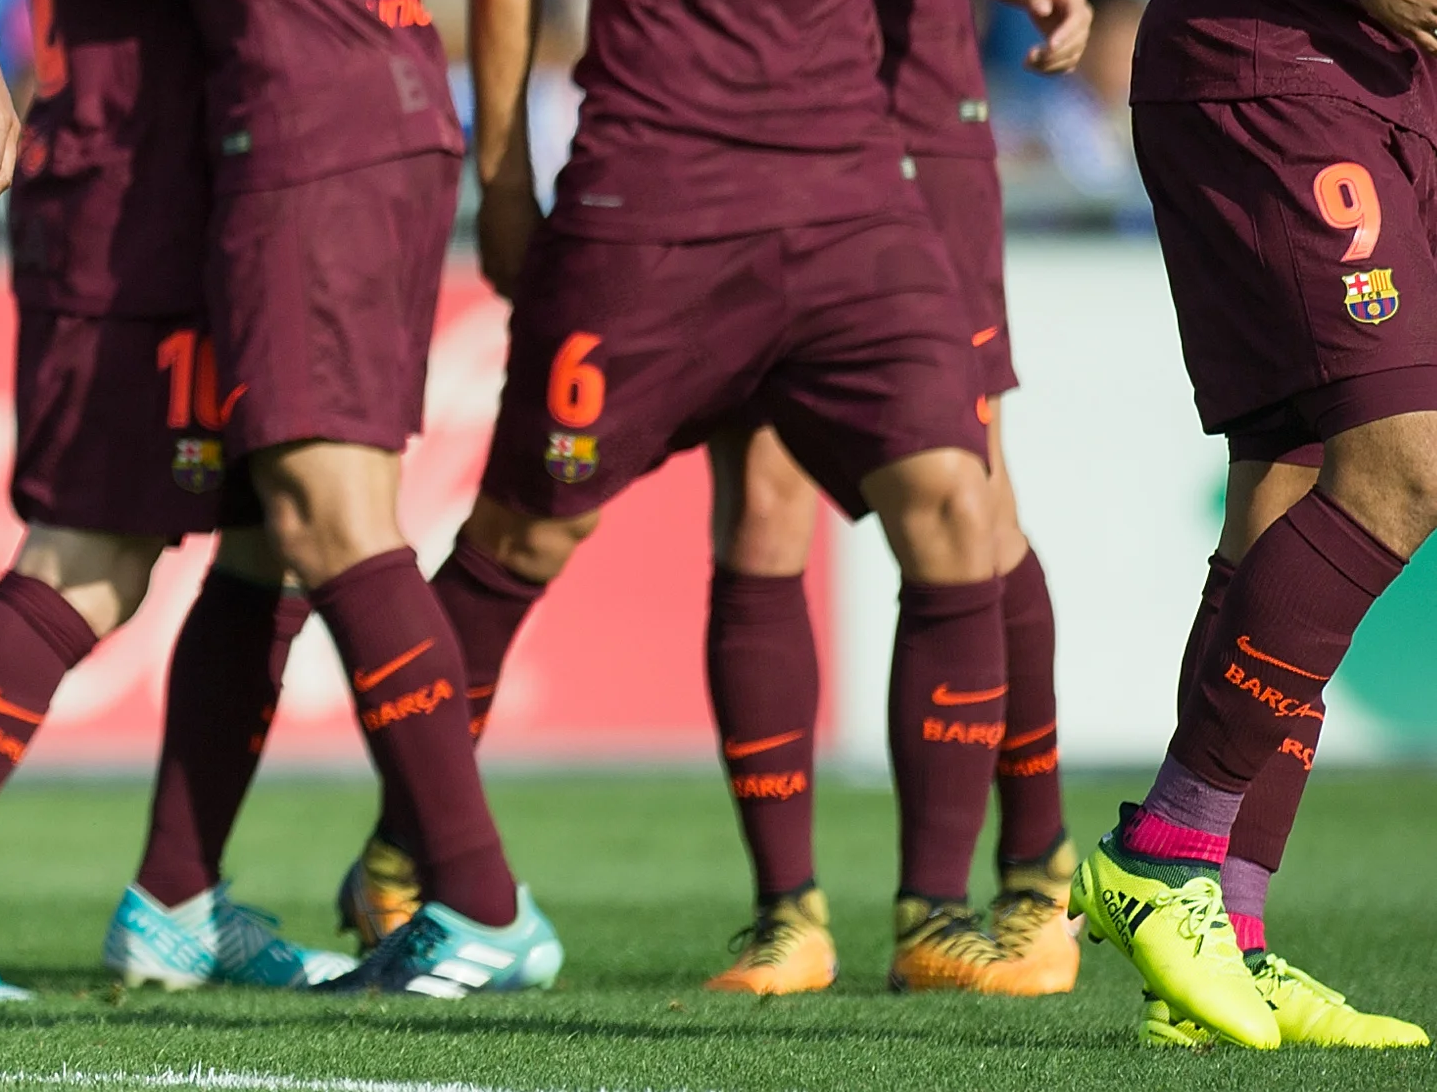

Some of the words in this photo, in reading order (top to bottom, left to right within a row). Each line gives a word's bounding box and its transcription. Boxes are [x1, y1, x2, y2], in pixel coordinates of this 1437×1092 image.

[1313, 162, 1382, 262] 9
[547, 331, 606, 428] 6
[1102, 889, 1135, 959] adidas
